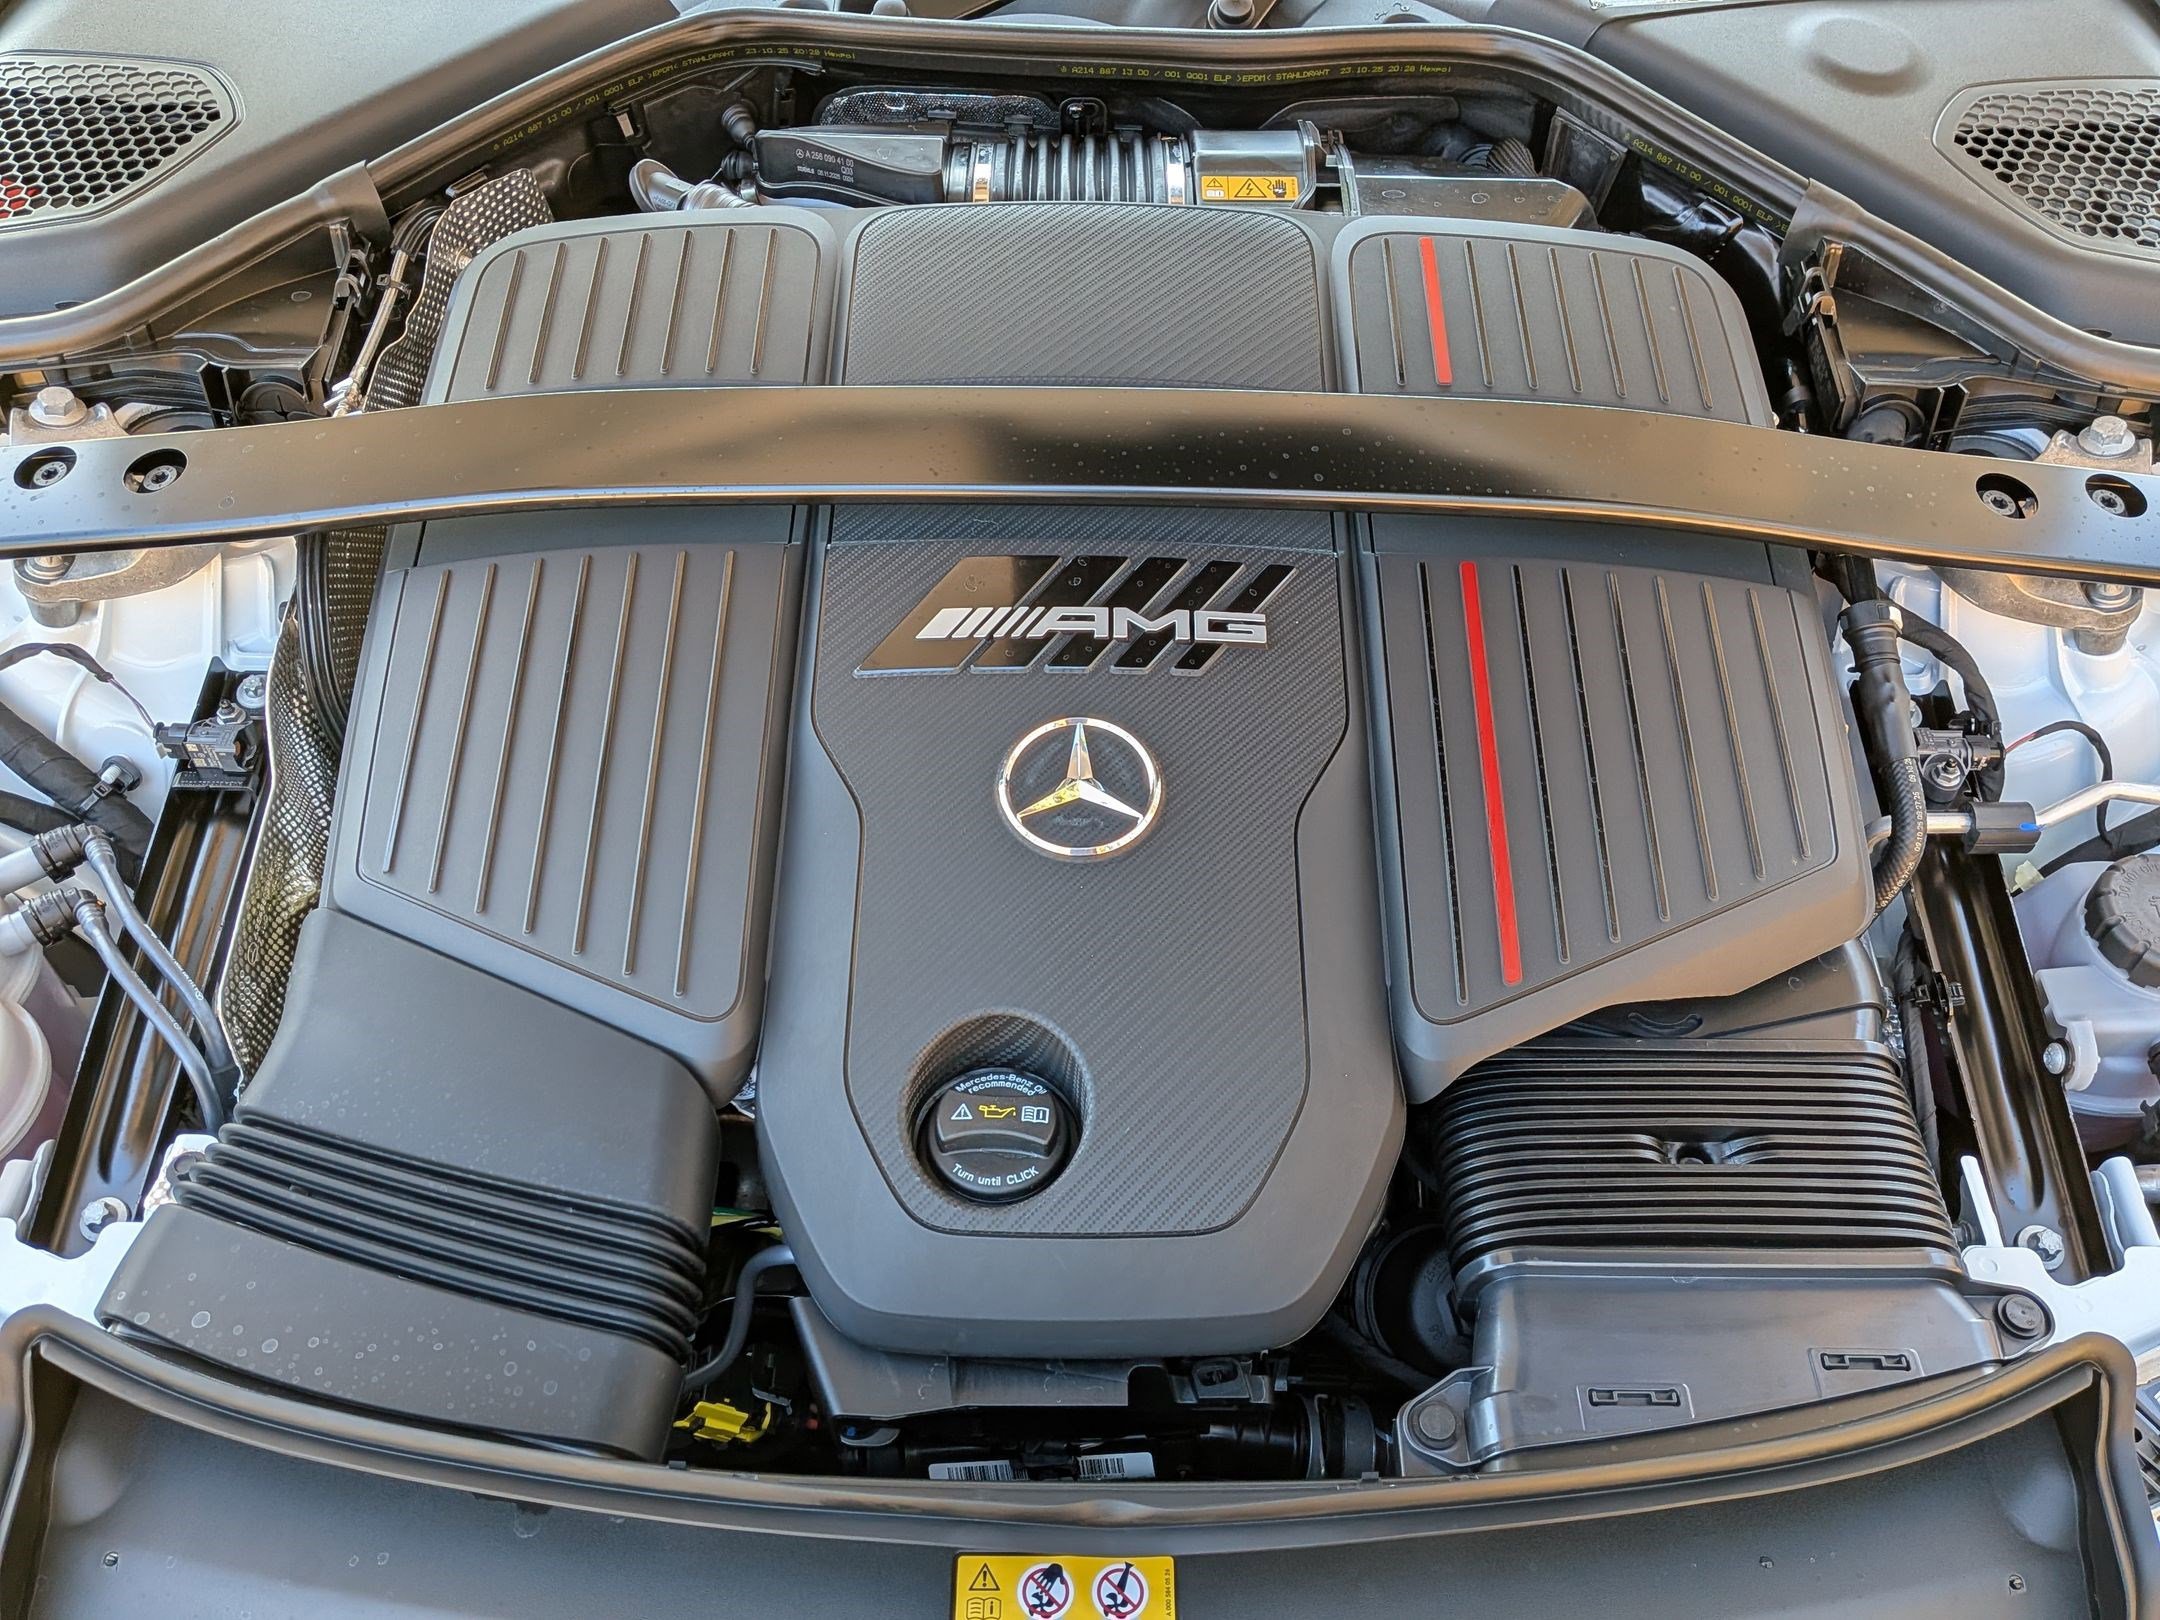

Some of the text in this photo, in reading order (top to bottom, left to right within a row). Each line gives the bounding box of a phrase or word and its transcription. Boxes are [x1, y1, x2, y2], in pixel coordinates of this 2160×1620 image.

[1071, 66, 1094, 74] A214
[1122, 68, 1133, 76] 13
[1213, 74, 1232, 84] ELP
[1275, 68, 1330, 81] STAHLDRAHT
[805, 150, 811, 159] A
[1633, 138, 1653, 155] A214
[1675, 163, 1687, 174] 13
[1713, 184, 1730, 198] 001
[1756, 209, 1774, 222] ELP
[1026, 606, 1268, 647] AMG
[955, 1073, 1048, 1094] Mercedes-Benz Oil
[968, 1080, 1035, 1096] recommended
[952, 1163, 1040, 1186] Turn until CLICK
